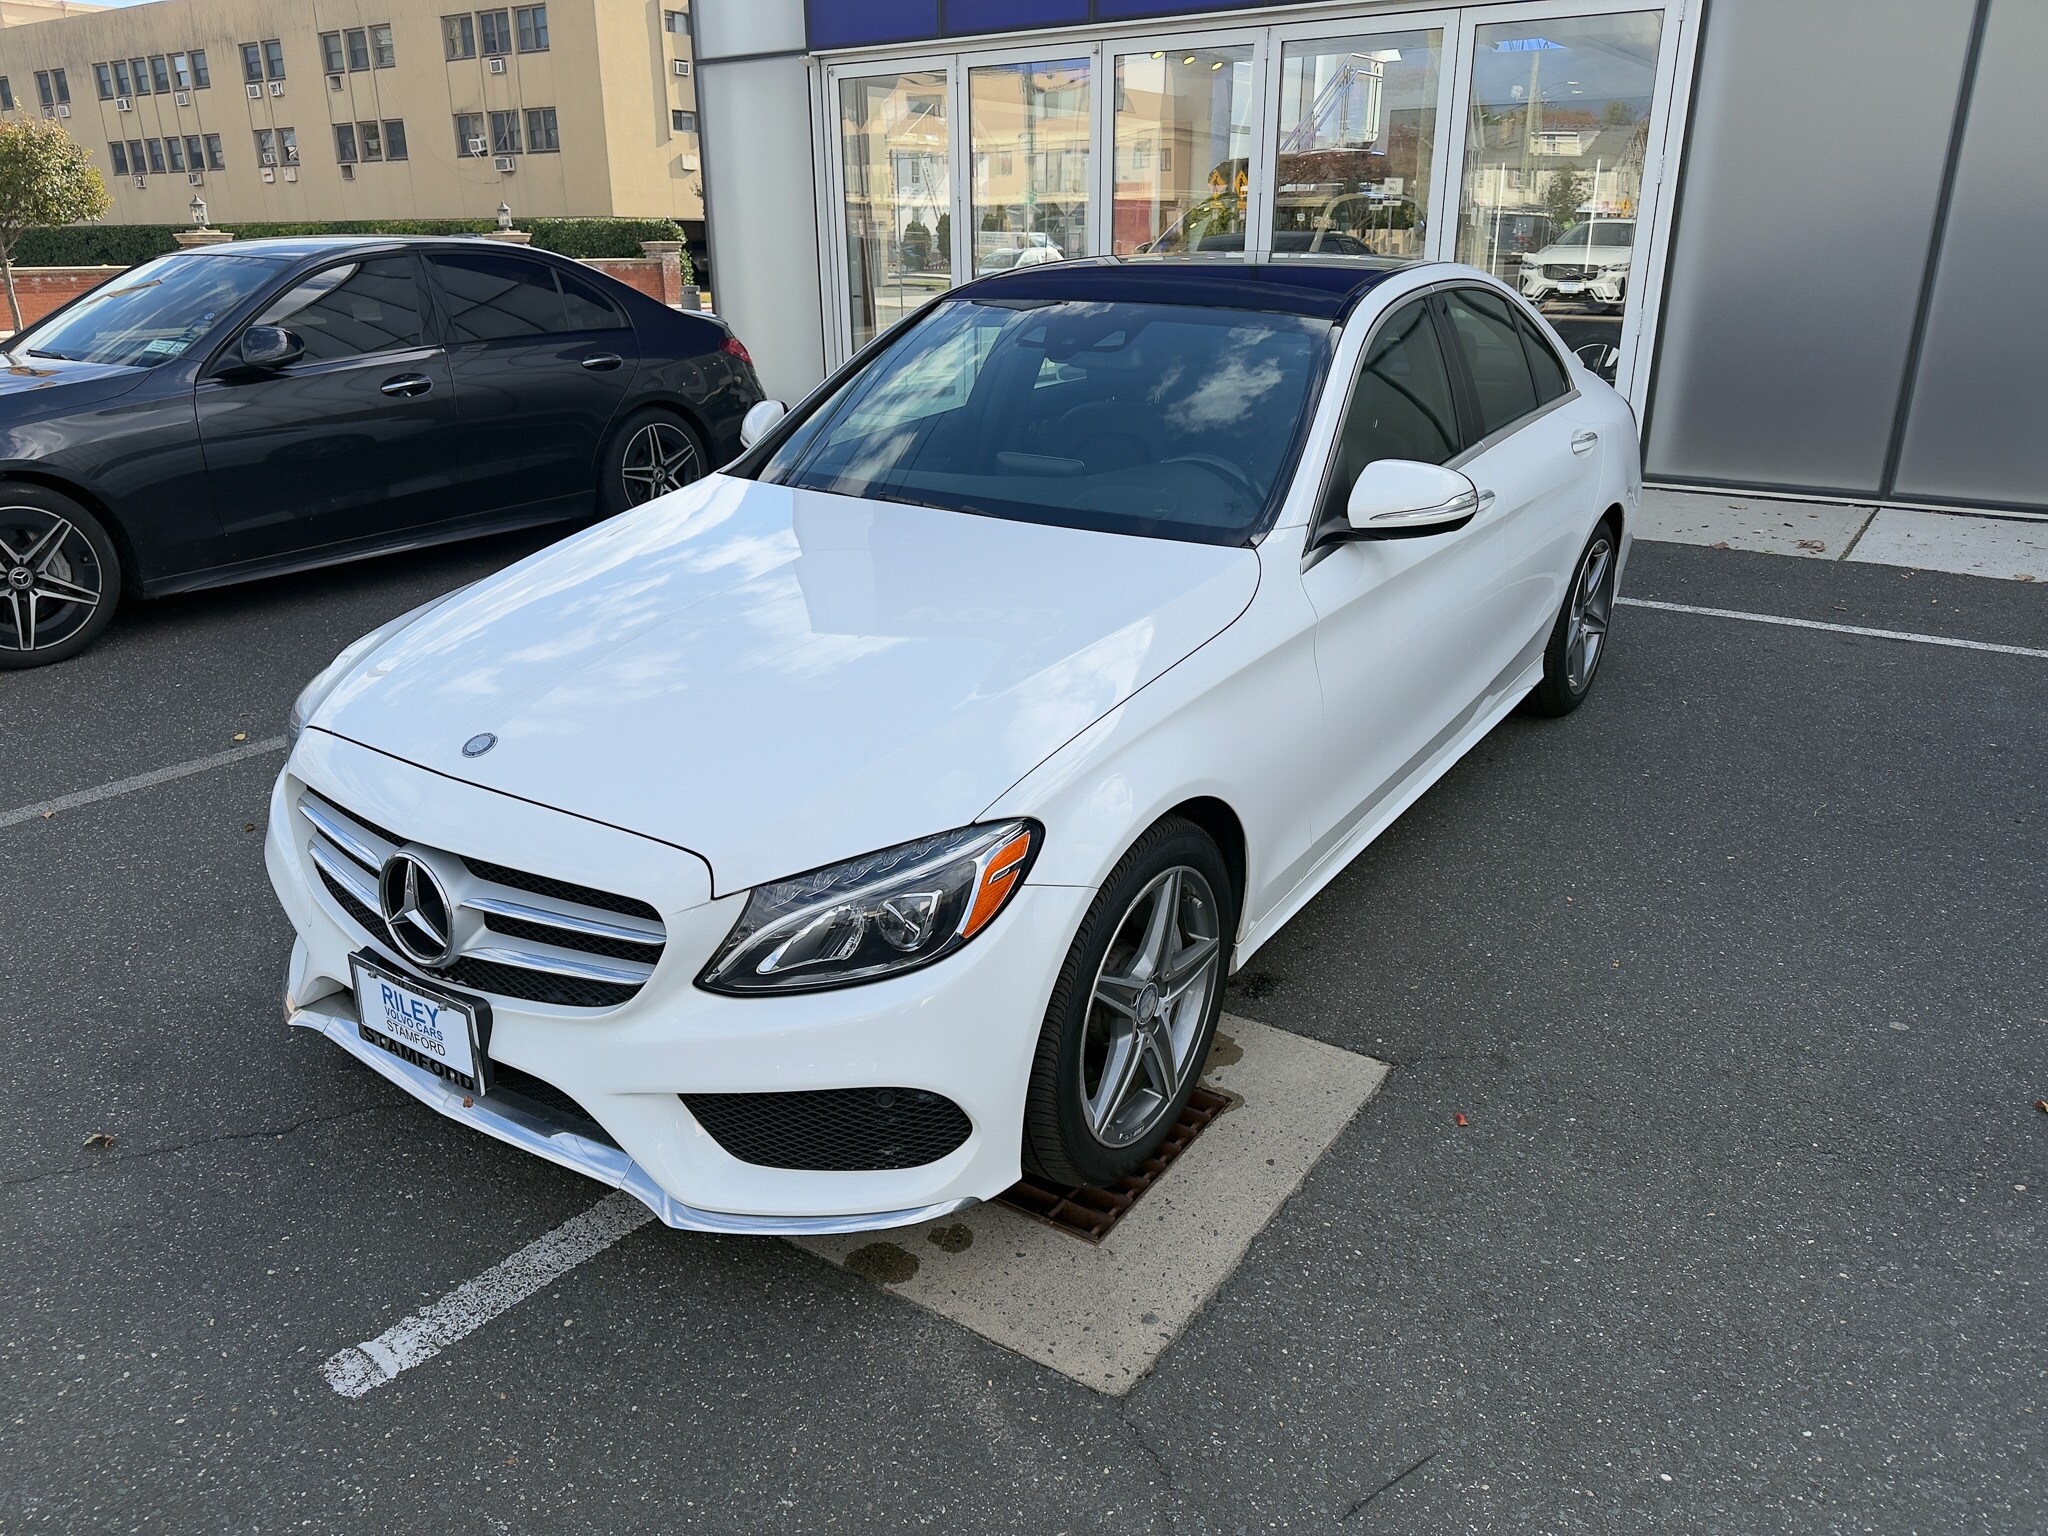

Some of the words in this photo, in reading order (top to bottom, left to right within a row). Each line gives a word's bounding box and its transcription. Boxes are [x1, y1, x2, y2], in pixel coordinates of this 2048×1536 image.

[381, 983, 439, 1028] RILEY
[384, 1005, 414, 1028] VOLVO
[416, 1022, 444, 1041] CARS
[364, 1026, 475, 1091] STAMFORD
[386, 1019, 446, 1057] STAMFORD
